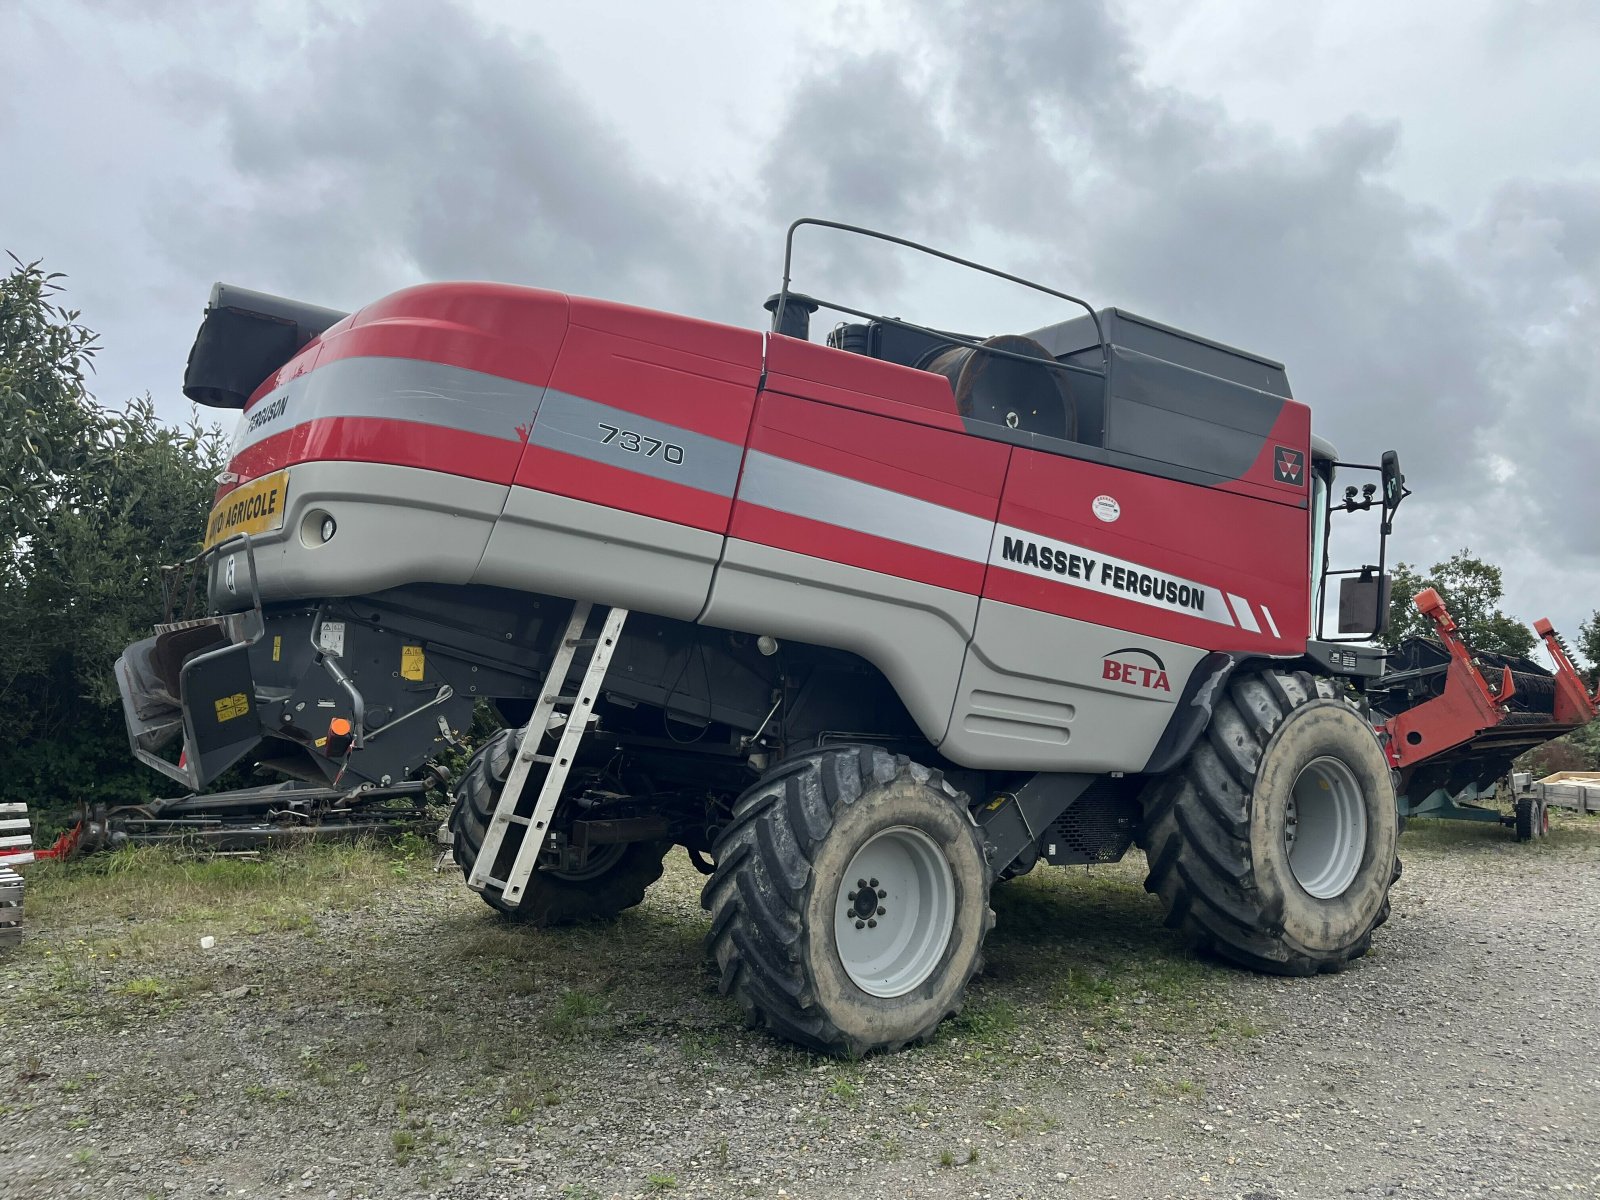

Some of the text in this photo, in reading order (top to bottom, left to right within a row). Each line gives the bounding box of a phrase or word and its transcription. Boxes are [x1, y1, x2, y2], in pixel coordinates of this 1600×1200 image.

[598, 422, 685, 466] 7370
[225, 489, 278, 528] AGRICOLE
[1002, 535, 1206, 611] MASSEY FERGUSON
[1101, 659, 1171, 692] BETA
